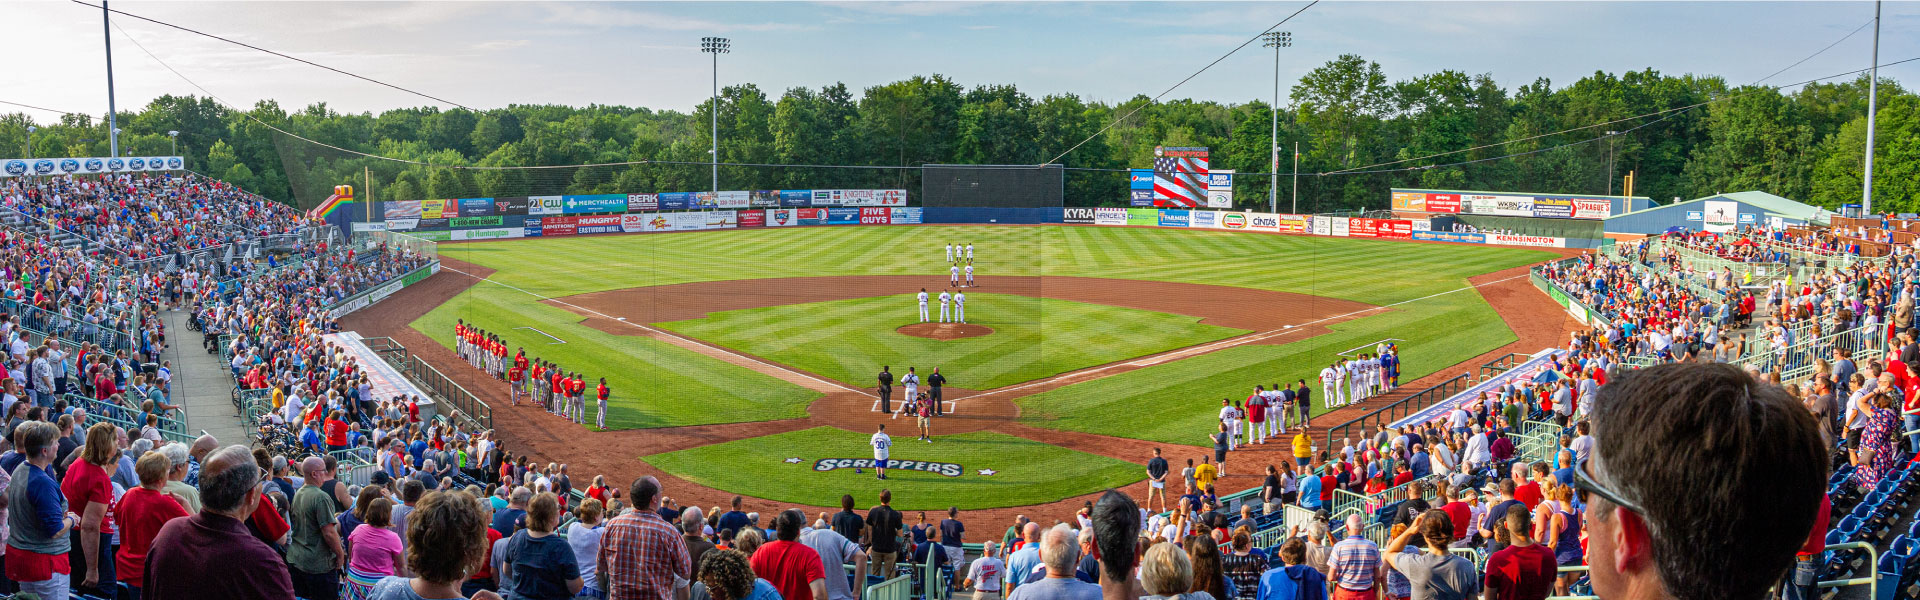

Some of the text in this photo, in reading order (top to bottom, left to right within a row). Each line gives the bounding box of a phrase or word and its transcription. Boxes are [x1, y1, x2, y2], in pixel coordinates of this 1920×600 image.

[1518, 202, 1533, 211] 27
[1578, 202, 1609, 211] SPRAGUE'S
[1064, 208, 1094, 218] KYRA
[1253, 217, 1276, 226] CINTAS
[606, 224, 620, 232] MALL
[1497, 235, 1554, 244] KENNSINGTON
[875, 441, 885, 449] 30
